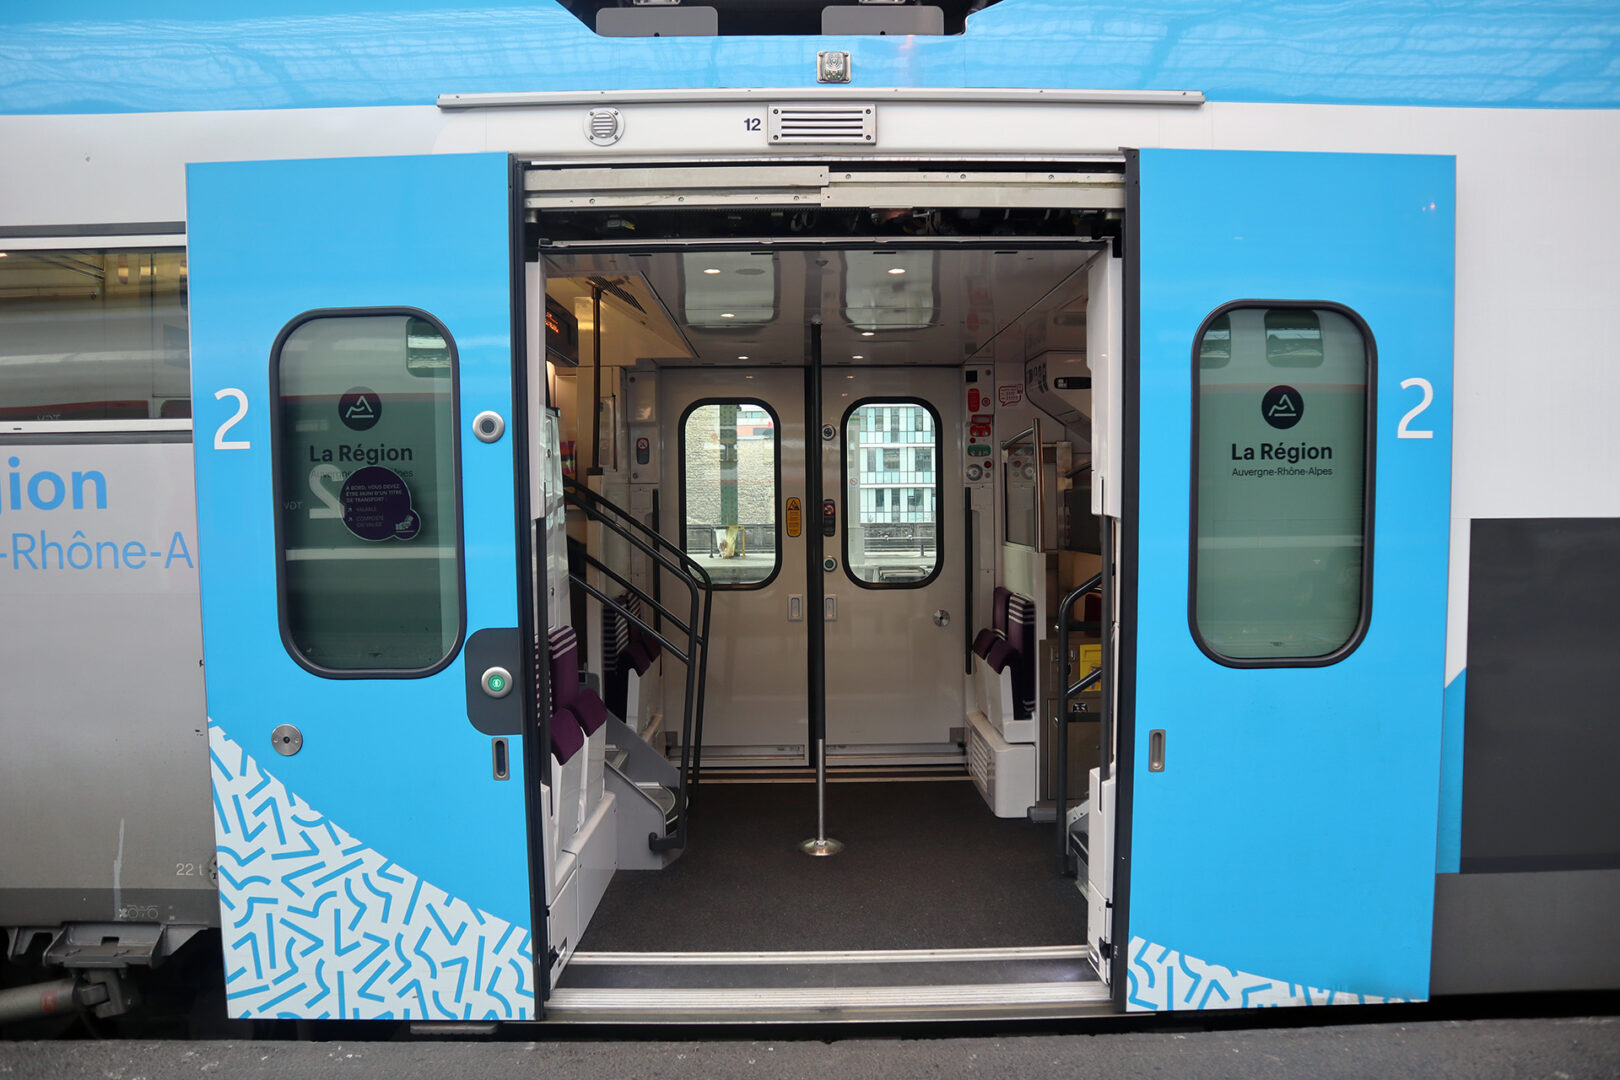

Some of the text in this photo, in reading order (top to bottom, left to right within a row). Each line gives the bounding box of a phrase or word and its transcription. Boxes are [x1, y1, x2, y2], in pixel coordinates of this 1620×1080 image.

[743, 117, 762, 132] 12
[213, 387, 251, 450] 2
[1396, 377, 1434, 439] 2
[309, 443, 413, 465] La Région
[1231, 442, 1333, 464] La Région
[1231, 466, 1333, 478] Auvergne-Rhône-Alpes
[0, 455, 108, 514] ion
[175, 862, 195, 876] 22
